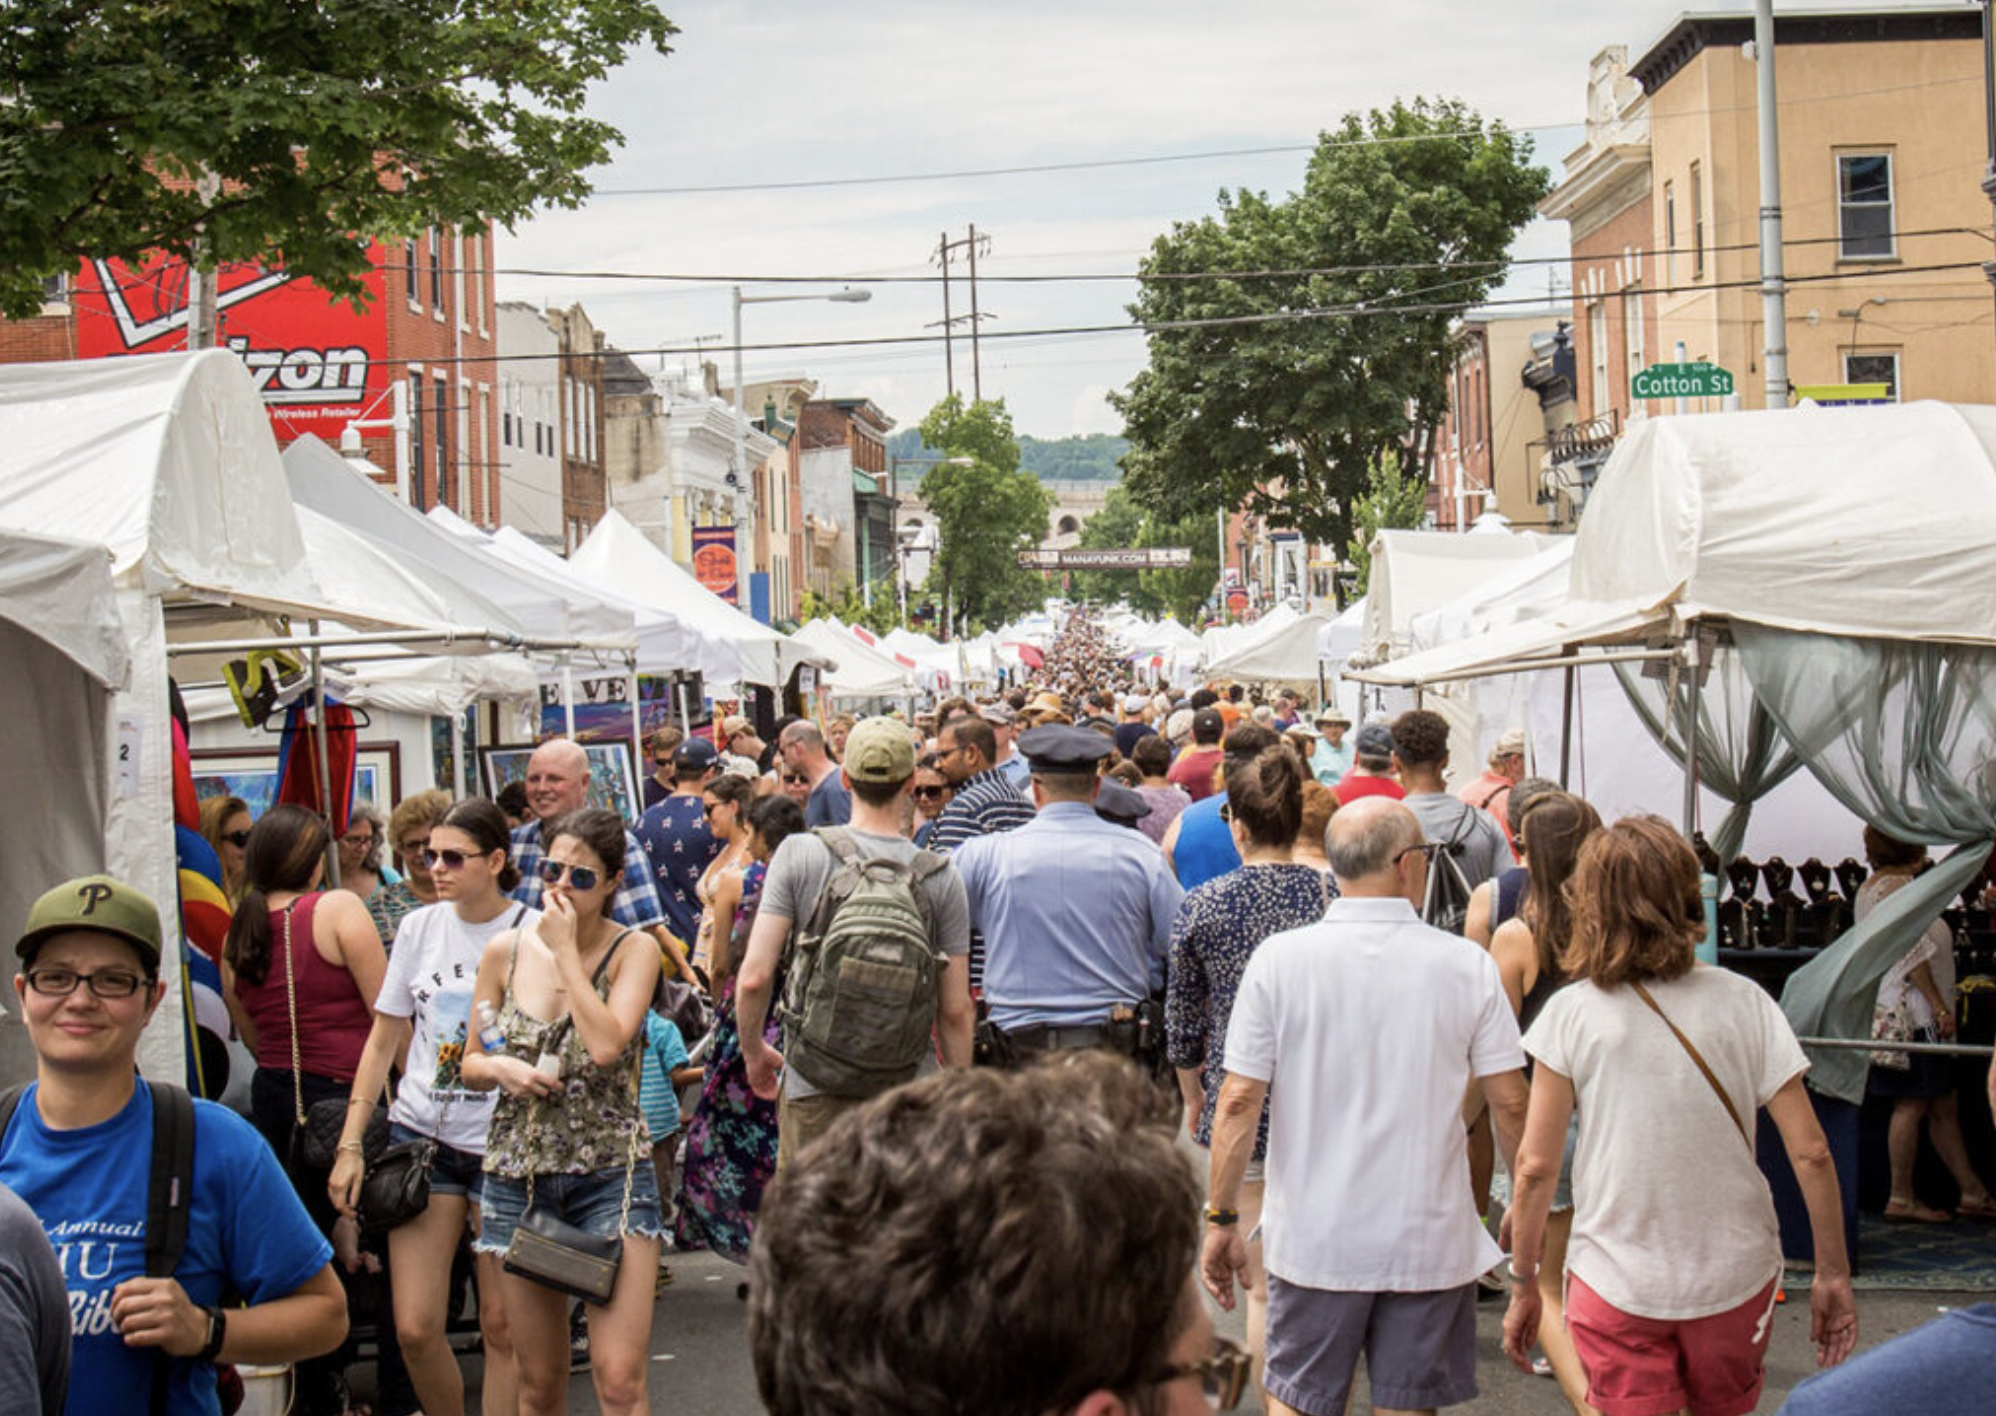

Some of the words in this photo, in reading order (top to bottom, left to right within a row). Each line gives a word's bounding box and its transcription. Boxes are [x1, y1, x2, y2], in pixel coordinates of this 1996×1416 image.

[1636, 375, 1703, 395] Cotton
[1710, 374, 1730, 393] St
[274, 408, 318, 419] Wireless
[321, 406, 360, 417] Retailer
[1062, 552, 1146, 565] MANAYUNK.COM
[78, 883, 113, 916] P
[49, 1219, 147, 1237] Annual
